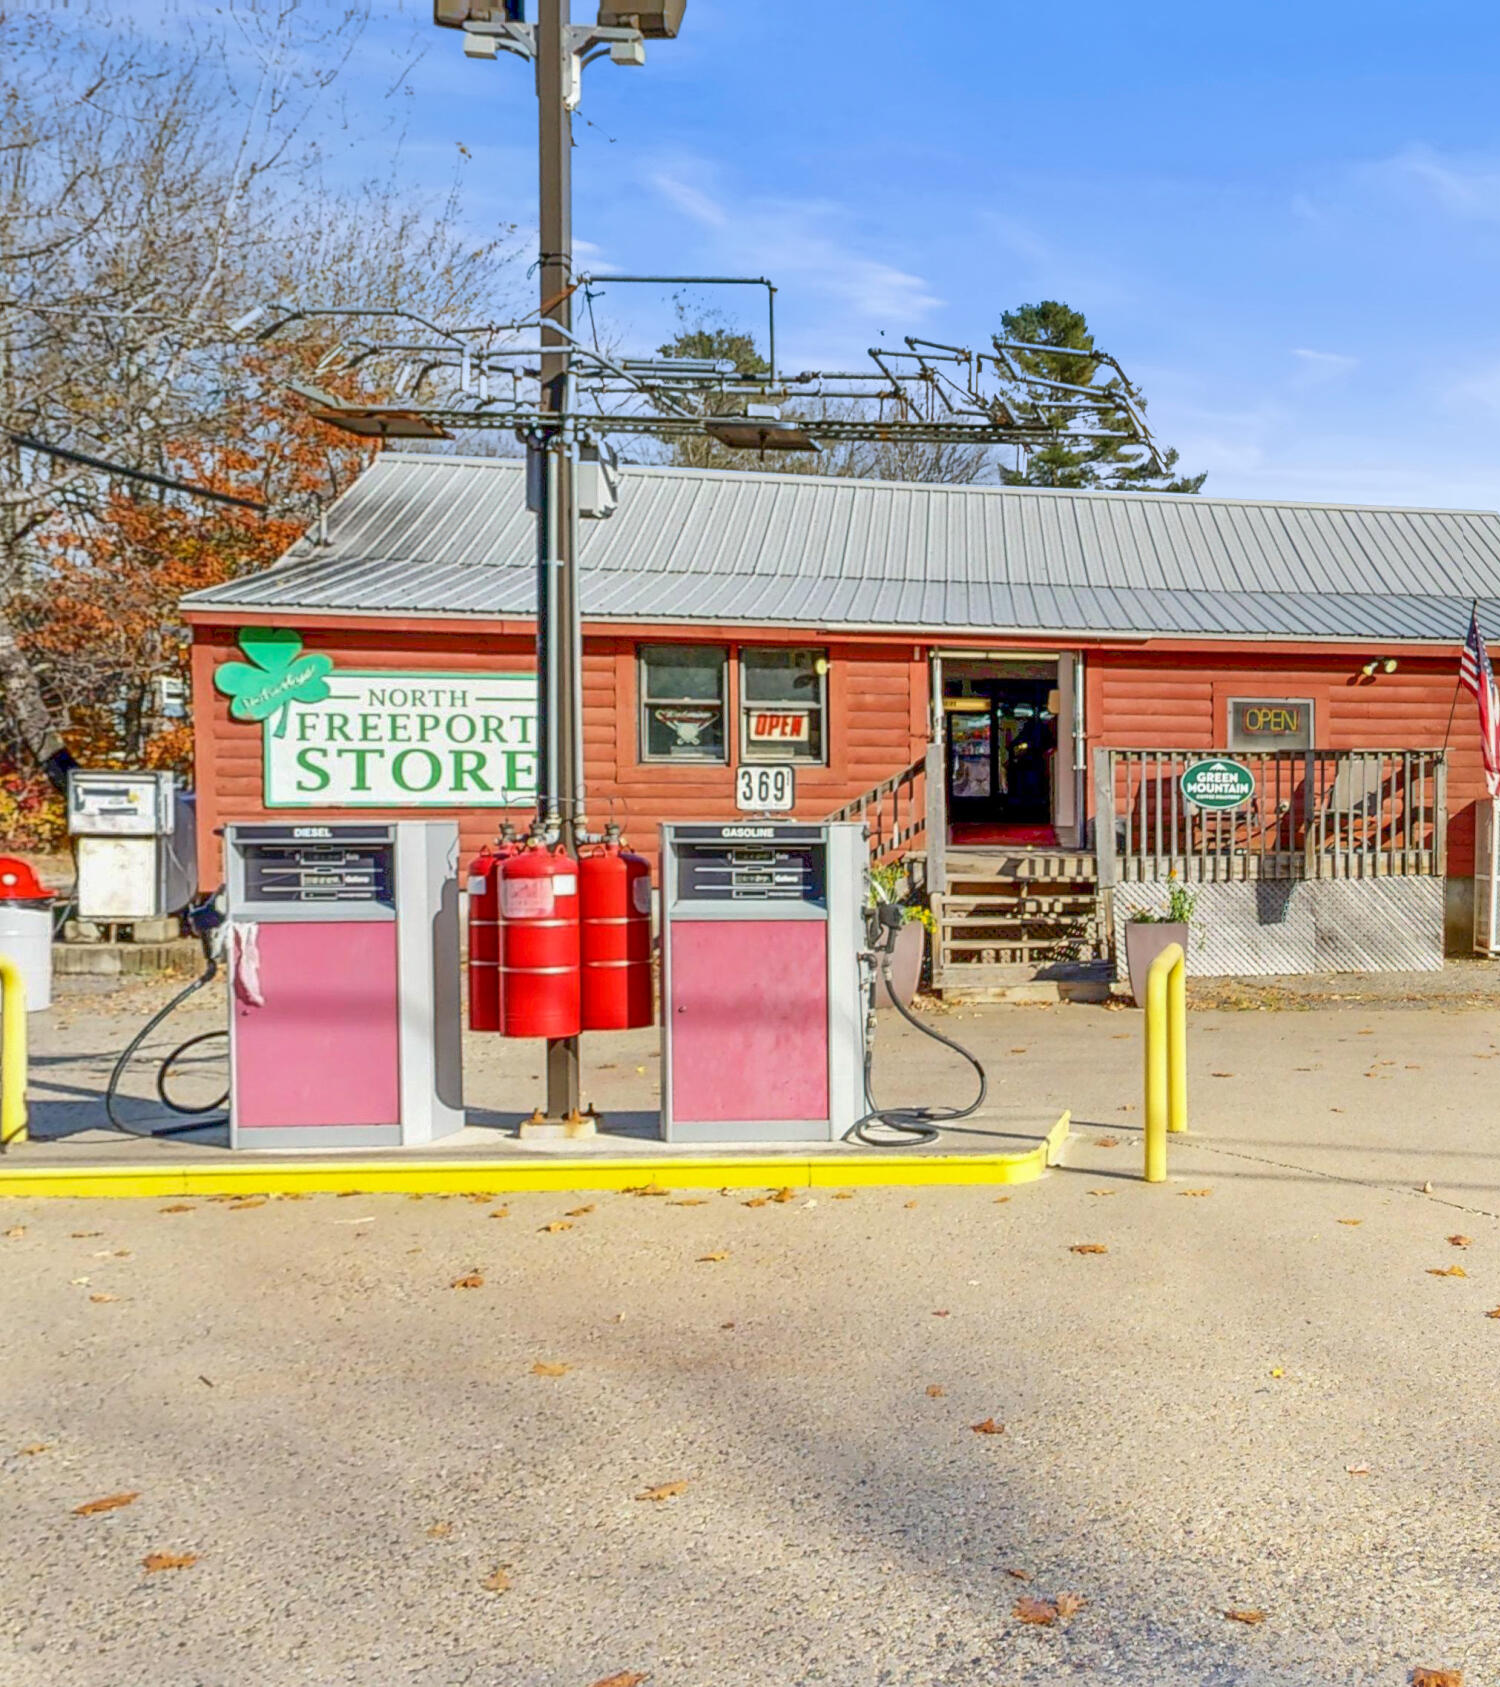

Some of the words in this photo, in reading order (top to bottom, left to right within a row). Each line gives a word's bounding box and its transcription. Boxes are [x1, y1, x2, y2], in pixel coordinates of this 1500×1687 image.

[368, 689, 468, 707] NORTH
[296, 713, 538, 743] FREEPORT
[754, 714, 803, 736] OPEN
[1246, 708, 1298, 731] OPEN
[296, 747, 539, 792] STORE
[1196, 771, 1239, 783] GREEN
[1186, 783, 1249, 794] MOUNTAIN
[293, 828, 333, 838] DIESEL
[721, 828, 775, 838] GASOLINE
